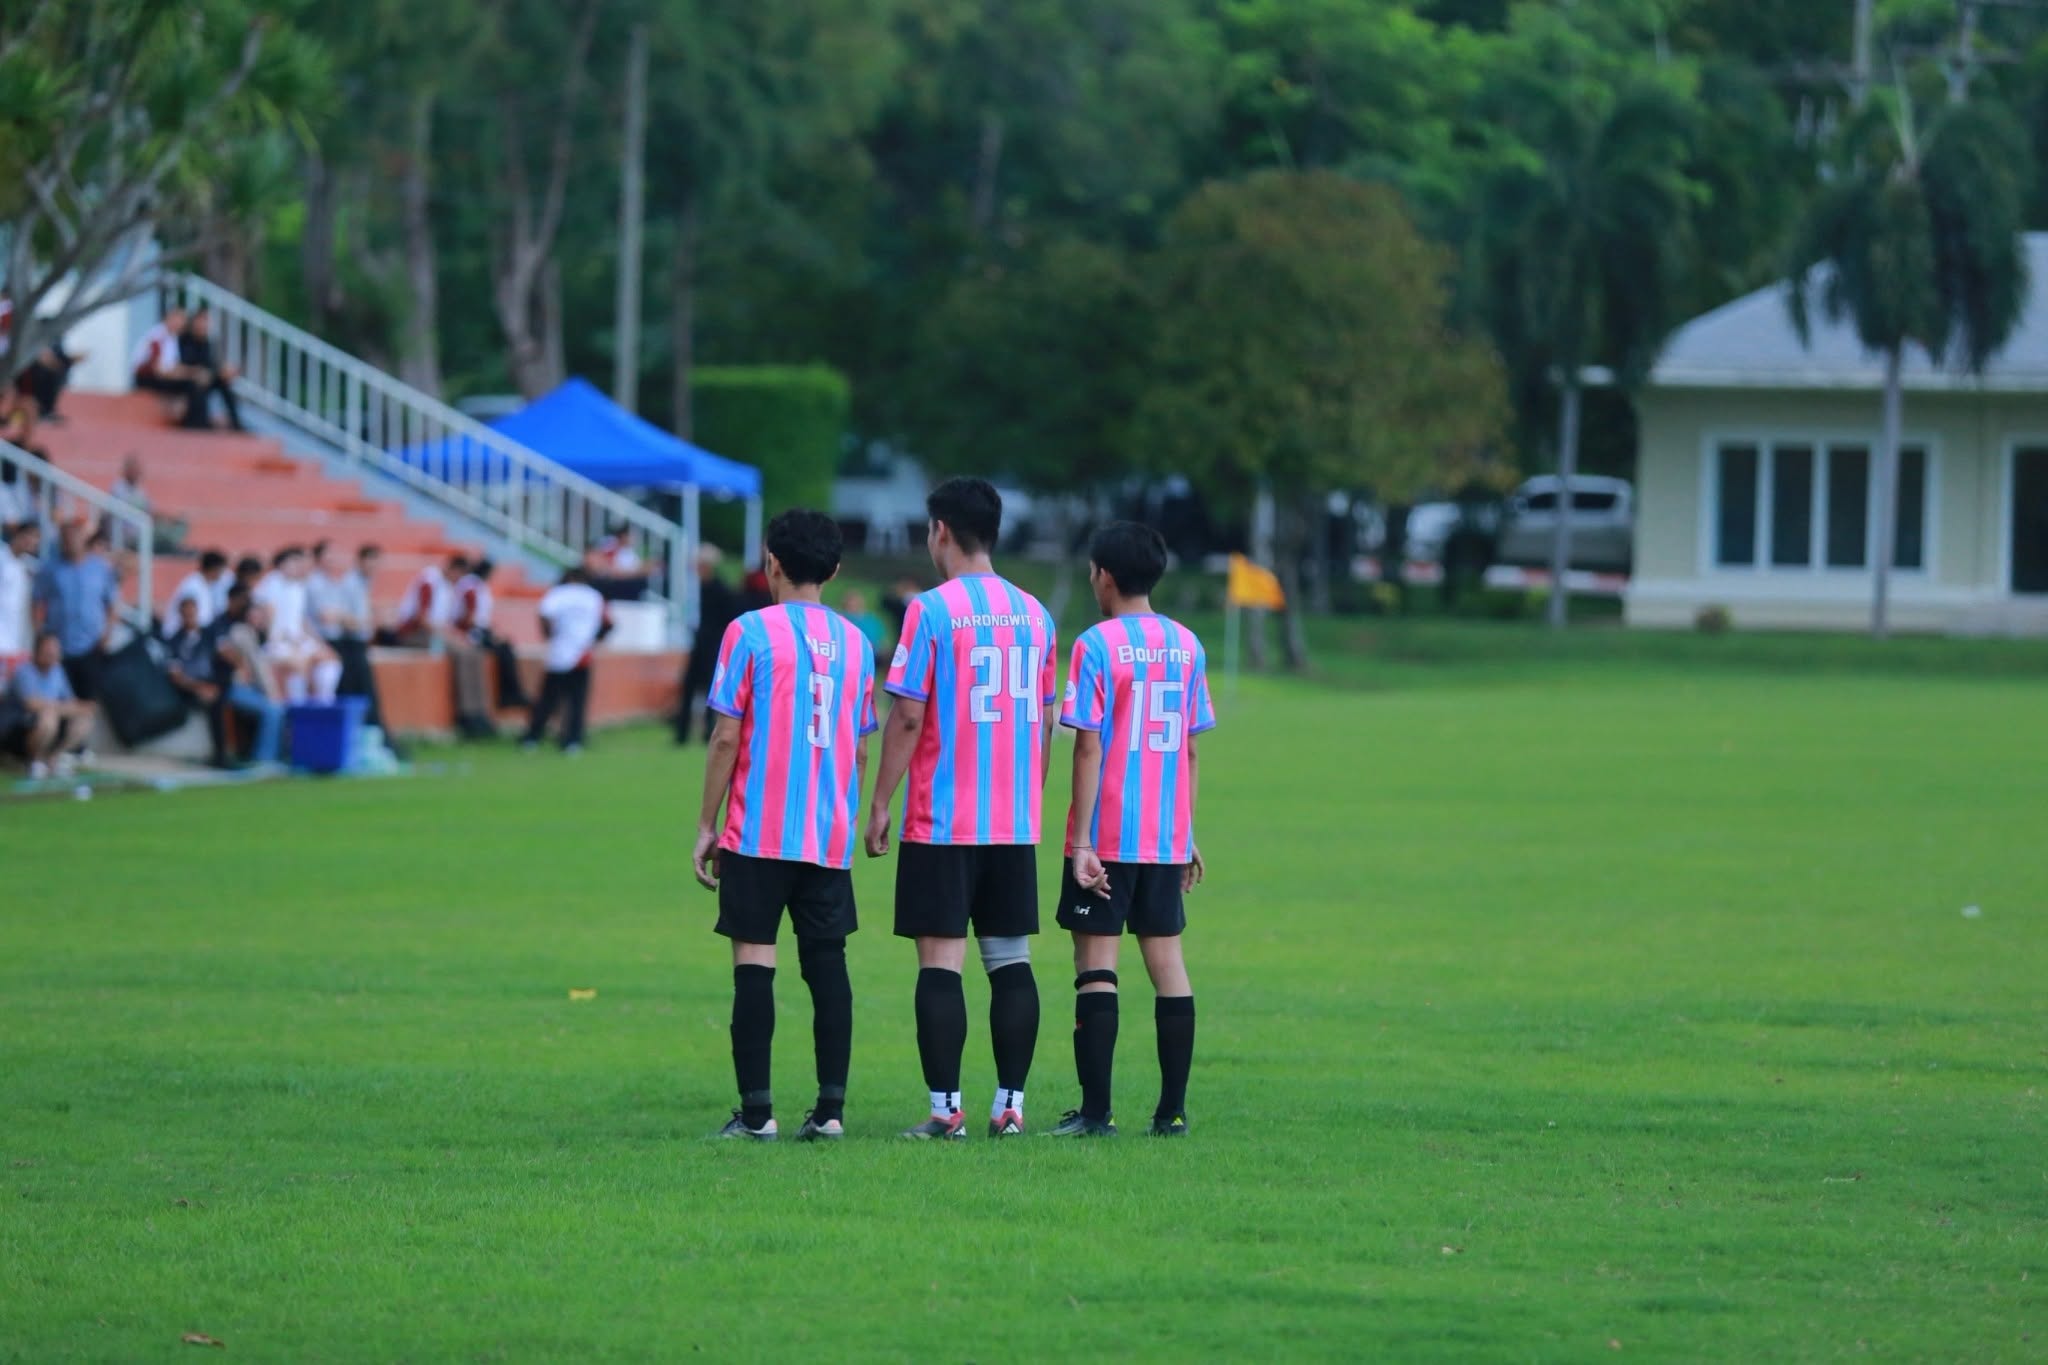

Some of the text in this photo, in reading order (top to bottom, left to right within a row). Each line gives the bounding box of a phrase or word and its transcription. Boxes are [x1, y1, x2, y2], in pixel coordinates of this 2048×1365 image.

[951, 614, 1031, 630] NARONGWIT
[1117, 644, 1192, 665] Bourne
[807, 671, 835, 749] 3
[970, 645, 1041, 723] 24
[1129, 680, 1185, 753] 15
